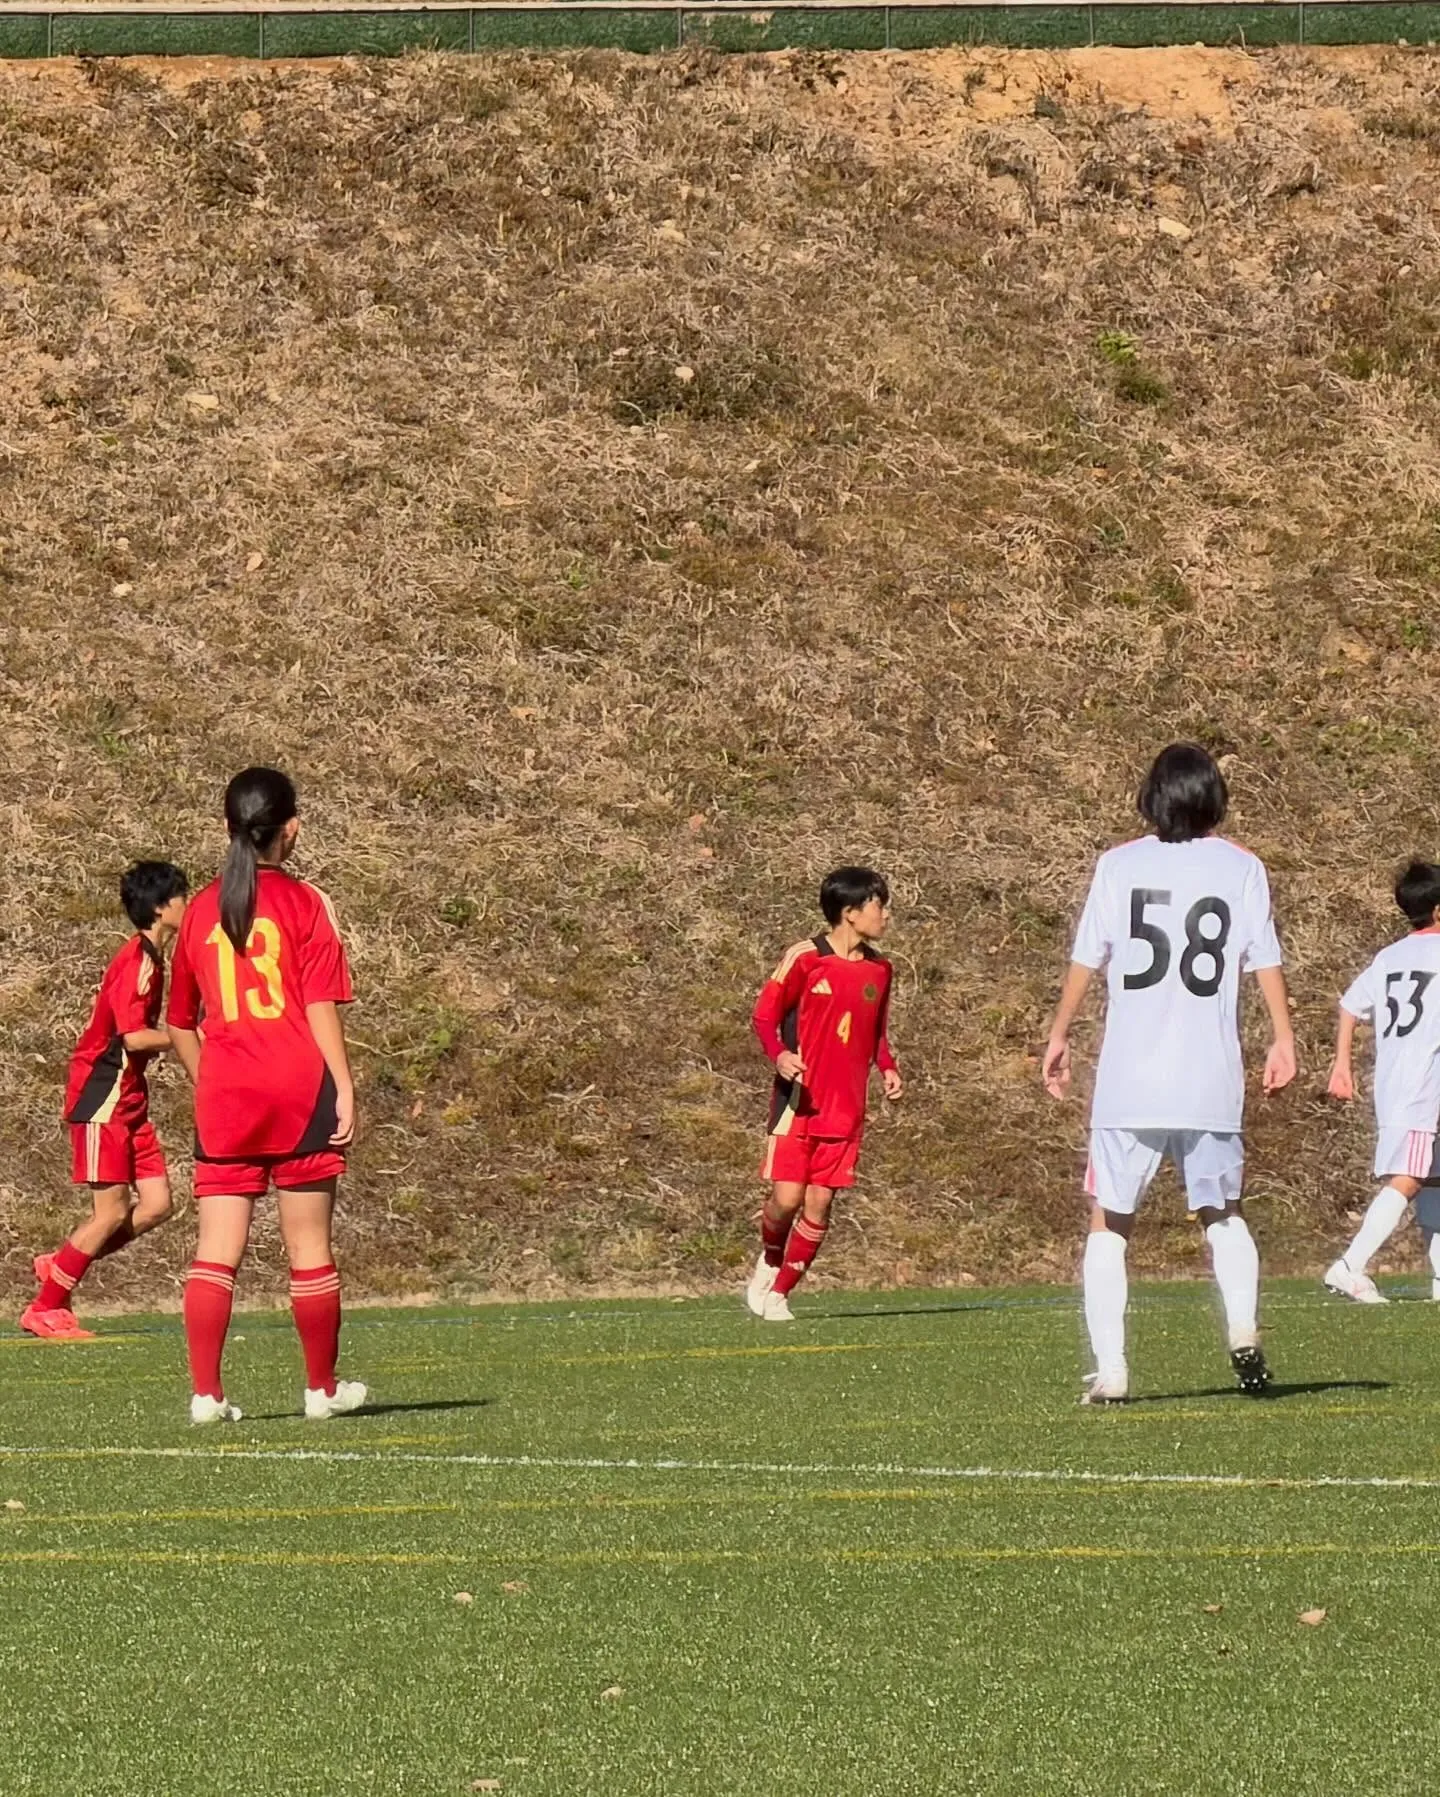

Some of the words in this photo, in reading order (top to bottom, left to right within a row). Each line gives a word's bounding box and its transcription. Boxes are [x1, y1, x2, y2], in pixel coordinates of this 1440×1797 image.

[206, 918, 285, 1022] 13
[1123, 888, 1231, 997] 58
[836, 1011, 852, 1044] 4
[1383, 971, 1437, 1038] 53
